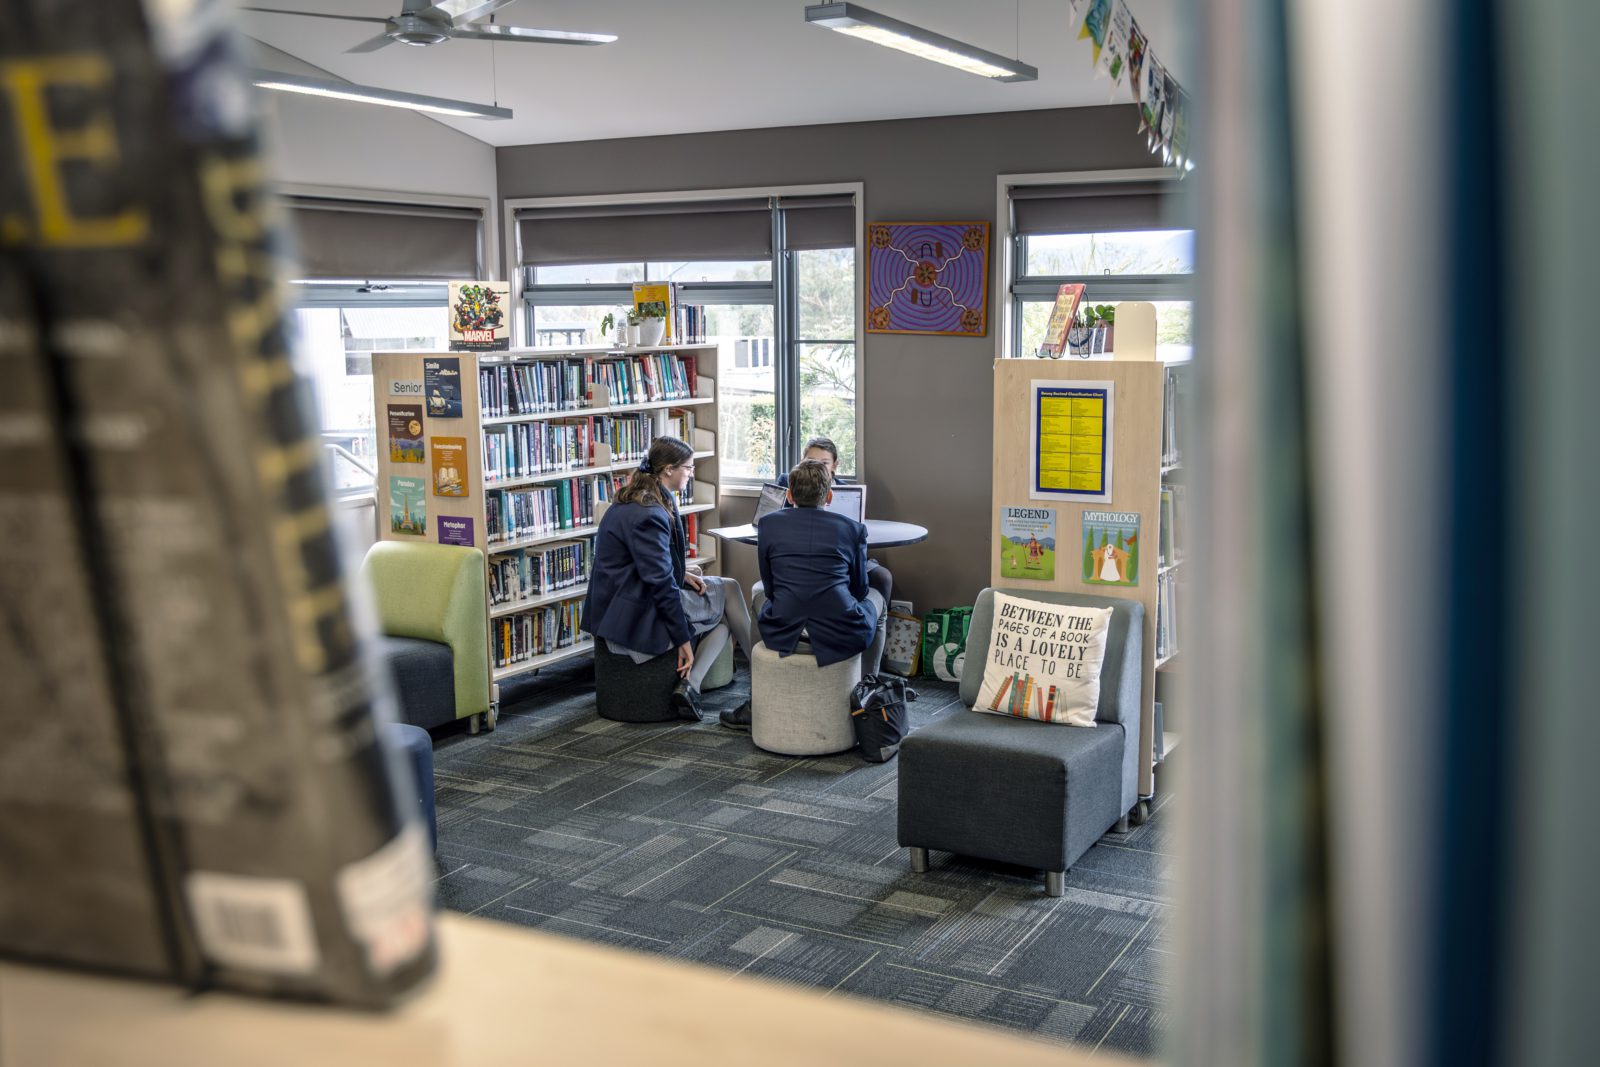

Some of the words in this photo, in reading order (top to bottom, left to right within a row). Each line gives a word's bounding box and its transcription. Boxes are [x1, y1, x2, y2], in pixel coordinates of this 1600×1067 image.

[464, 330, 494, 342] MARVEL
[394, 382, 422, 393] Senior
[1008, 508, 1049, 520] LEGEND
[1084, 512, 1138, 523] MYTHOLOGY
[443, 521, 466, 529] Metaphor
[1000, 603, 1064, 628] BETWEEN
[1067, 615, 1093, 631] THE
[998, 618, 1029, 635] PAGES
[1032, 627, 1047, 638] OF
[1049, 630, 1056, 640] A
[1060, 631, 1090, 644] BOOK
[996, 632, 1009, 648] IS
[1014, 637, 1023, 652] A
[1030, 640, 1087, 661] LOVELY
[994, 649, 1030, 671] PLACE
[1041, 659, 1056, 675] TO
[1067, 662, 1083, 679] BE
